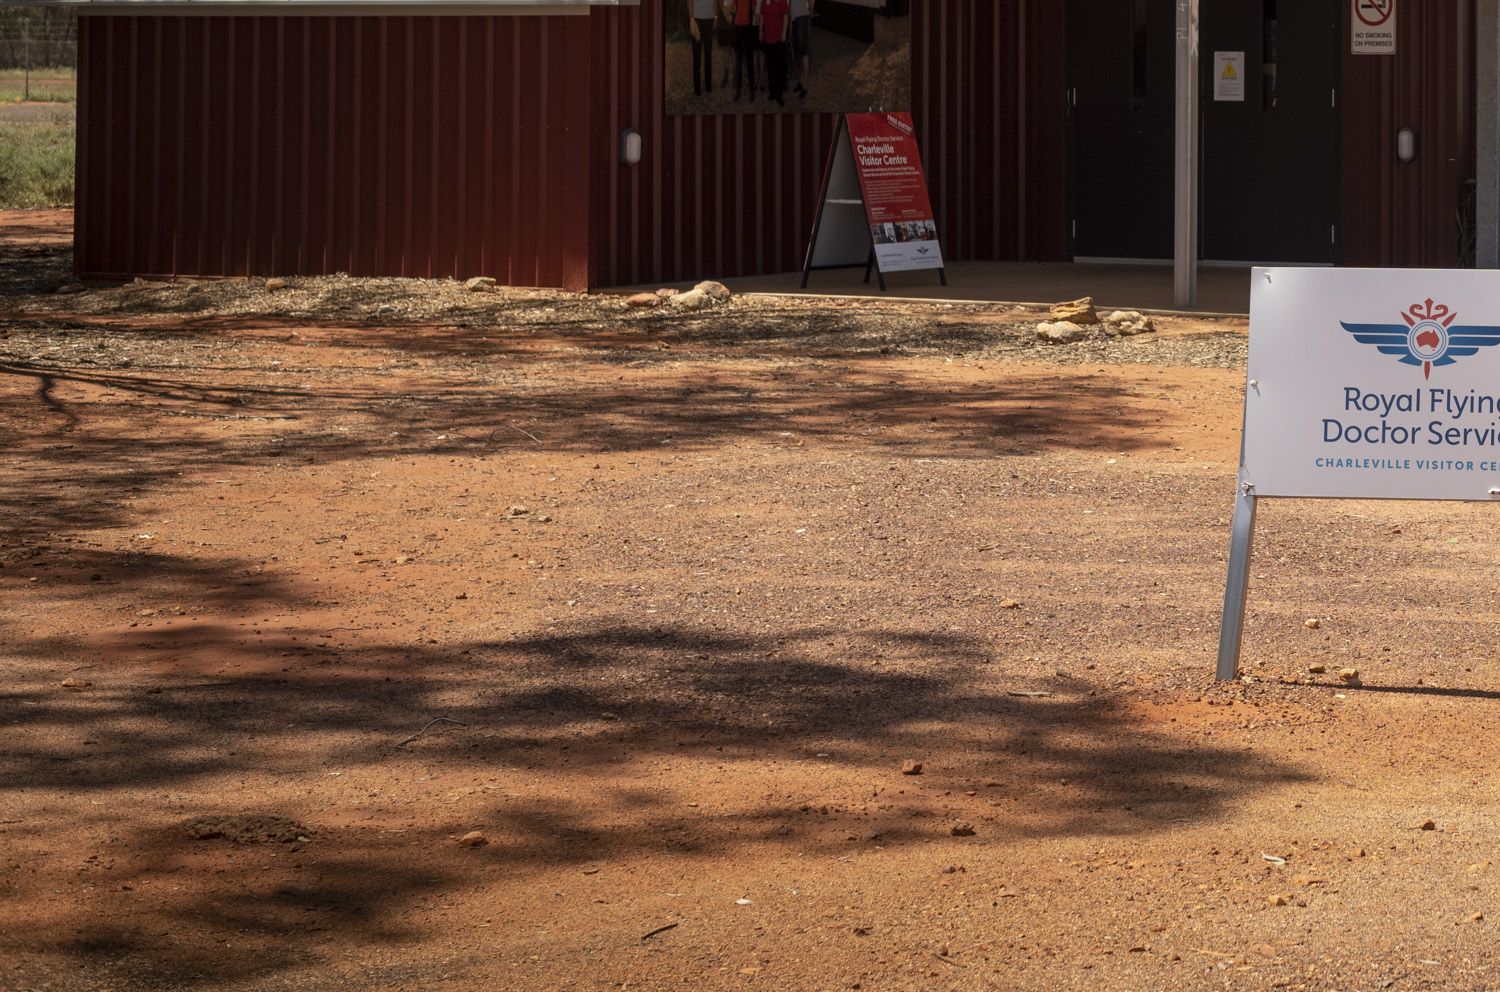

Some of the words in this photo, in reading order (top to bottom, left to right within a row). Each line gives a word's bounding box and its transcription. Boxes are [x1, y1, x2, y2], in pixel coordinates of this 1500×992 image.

[857, 144, 894, 155] Charleville
[860, 156, 883, 166] Visitor
[883, 154, 908, 166] Centre
[1344, 387, 1420, 418] Royal
[1323, 419, 1421, 444] Doctor
[1316, 458, 1410, 469] CHARLEVILLE
[1416, 460, 1473, 470] VISITOR
